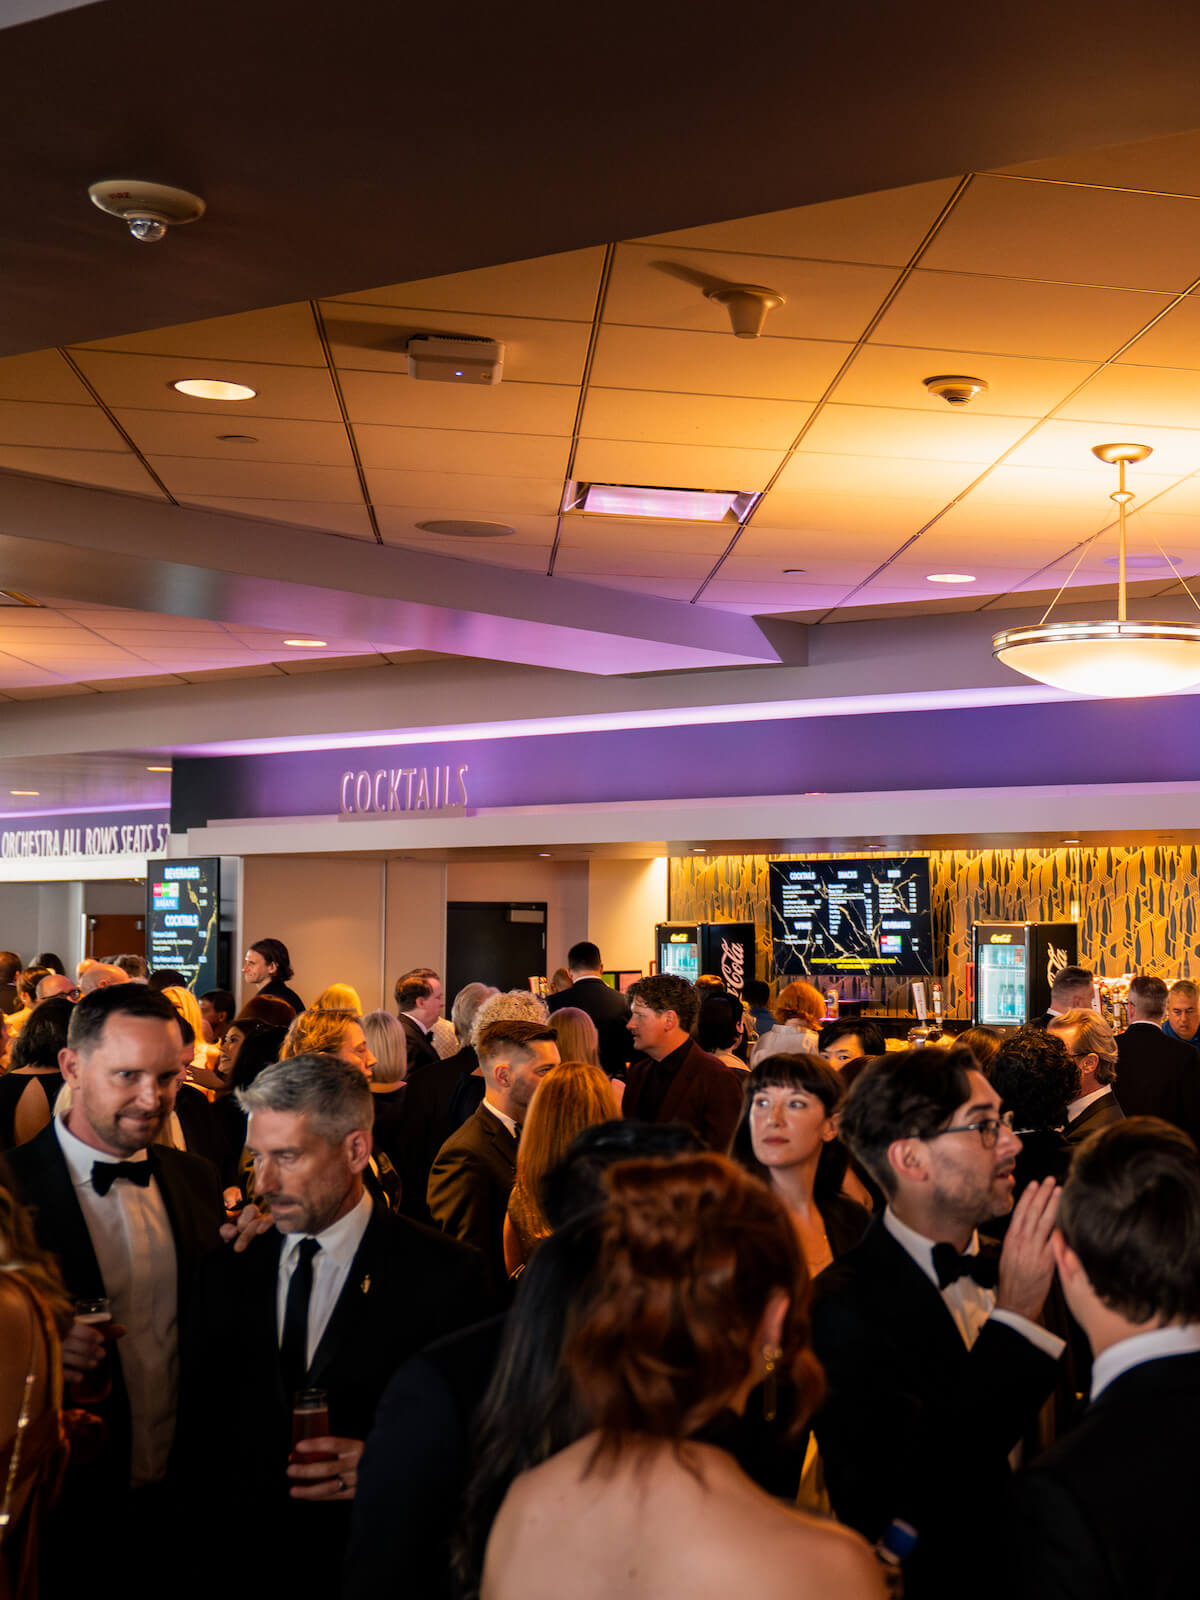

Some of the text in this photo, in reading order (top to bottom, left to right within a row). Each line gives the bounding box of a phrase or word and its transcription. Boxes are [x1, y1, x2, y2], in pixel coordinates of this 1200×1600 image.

[340, 764, 468, 812] COCKTAILS
[1, 830, 59, 858] ORCHESTRA
[62, 827, 82, 857] ALL
[85, 825, 118, 855] ROWS
[120, 823, 153, 853] SEATS
